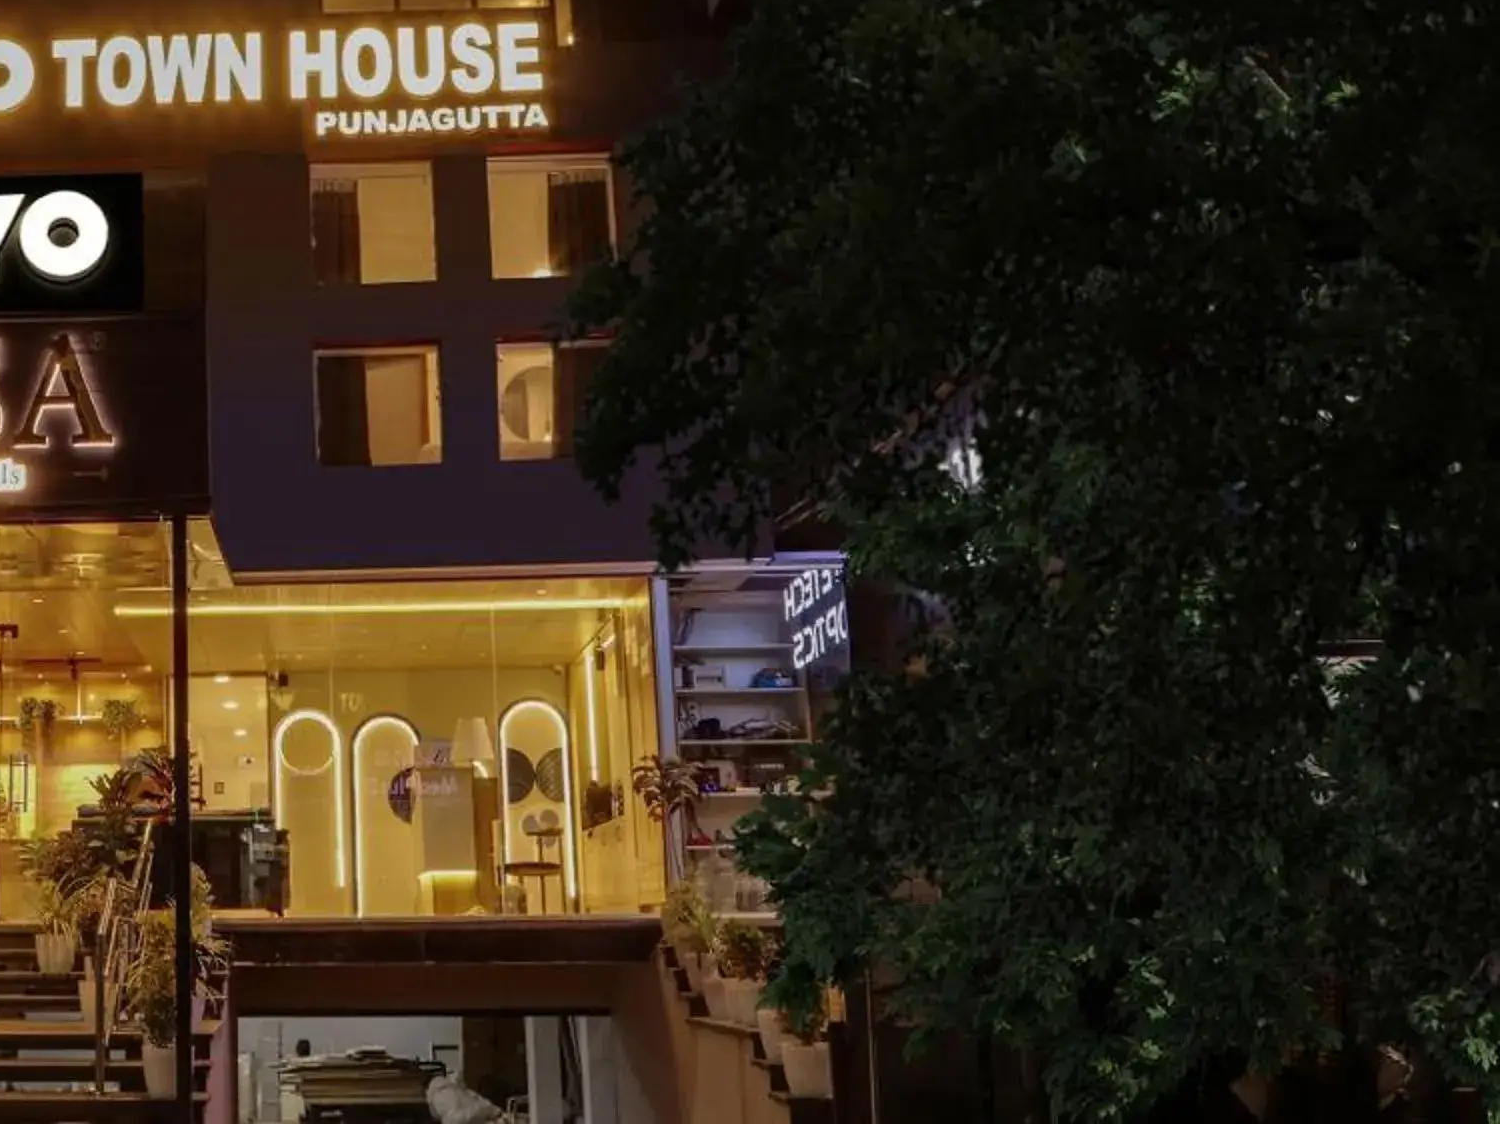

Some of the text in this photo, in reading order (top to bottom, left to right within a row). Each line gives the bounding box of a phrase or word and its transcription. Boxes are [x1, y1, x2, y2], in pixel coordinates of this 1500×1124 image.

[52, 32, 263, 108] TOWN
[288, 21, 544, 99] HOUSE
[315, 103, 550, 137] PUNJAGUTTA
